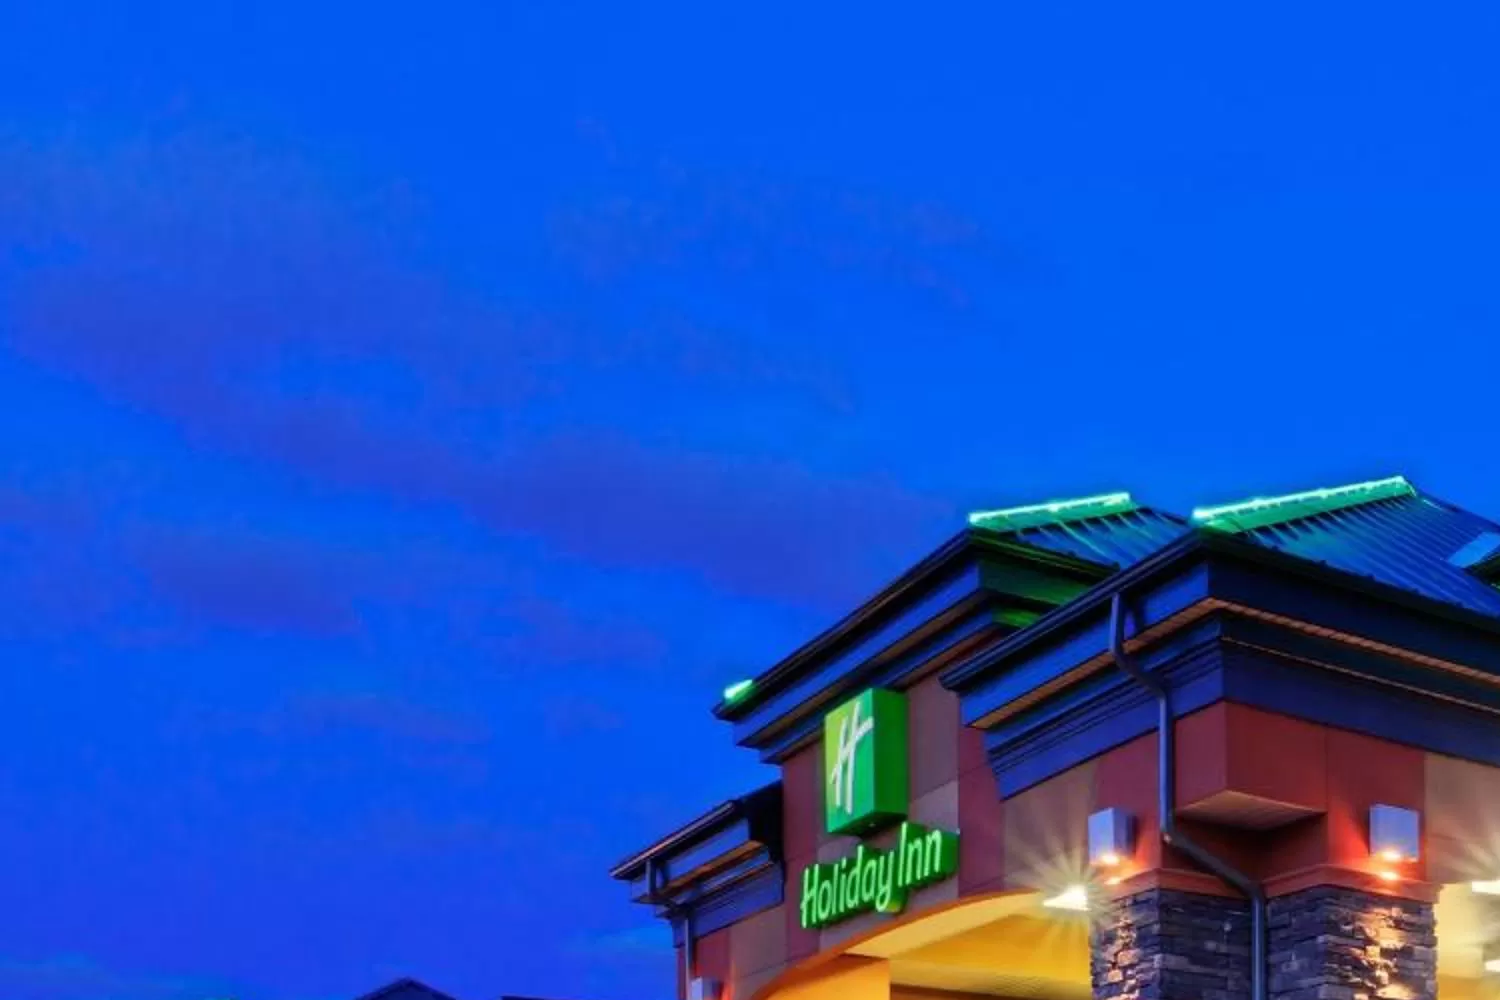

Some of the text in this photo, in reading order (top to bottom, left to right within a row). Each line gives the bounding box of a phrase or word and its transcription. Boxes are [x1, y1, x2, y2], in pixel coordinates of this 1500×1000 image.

[831, 699, 873, 814] H
[801, 822, 941, 927] Holiday Inn
